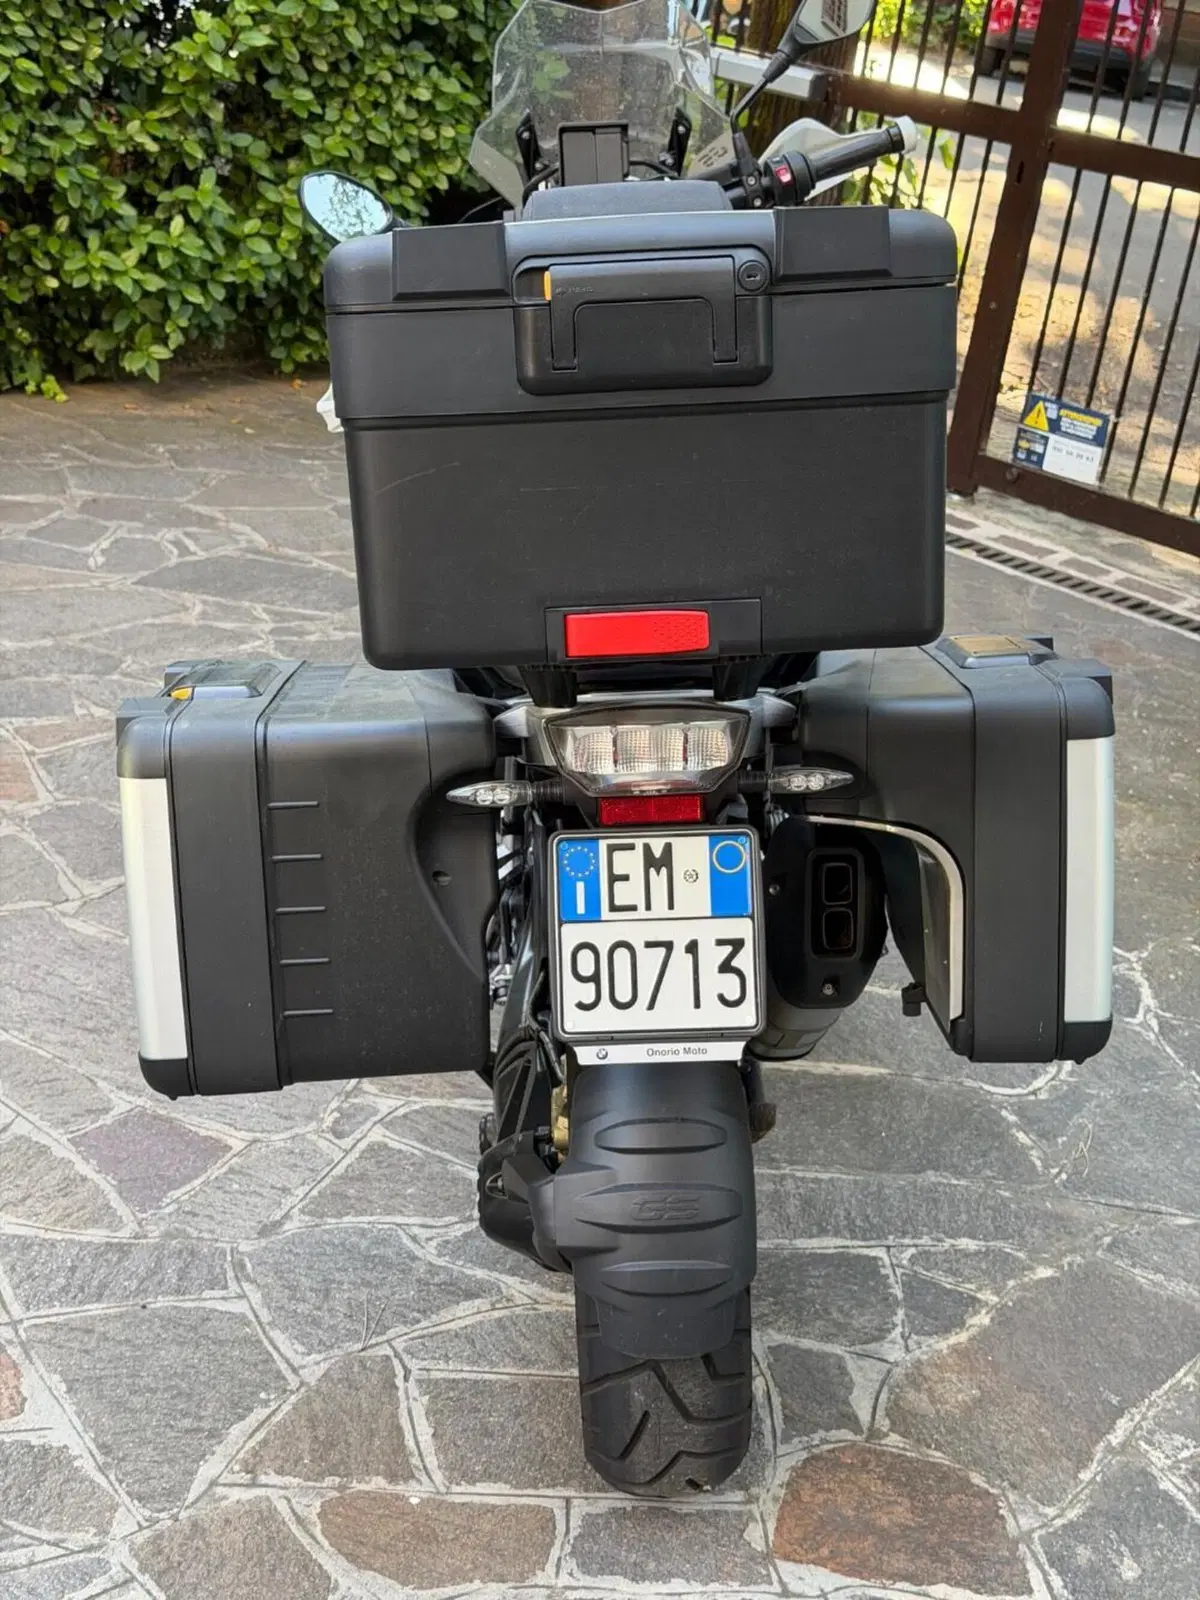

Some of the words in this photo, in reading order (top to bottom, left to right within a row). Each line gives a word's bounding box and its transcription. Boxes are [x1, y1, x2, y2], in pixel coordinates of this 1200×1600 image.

[606, 842, 675, 913] EM
[570, 937, 747, 1012] 90713
[646, 1048, 680, 1058] Onorio
[683, 1046, 708, 1056] Moto
[630, 1195, 701, 1221] GS
